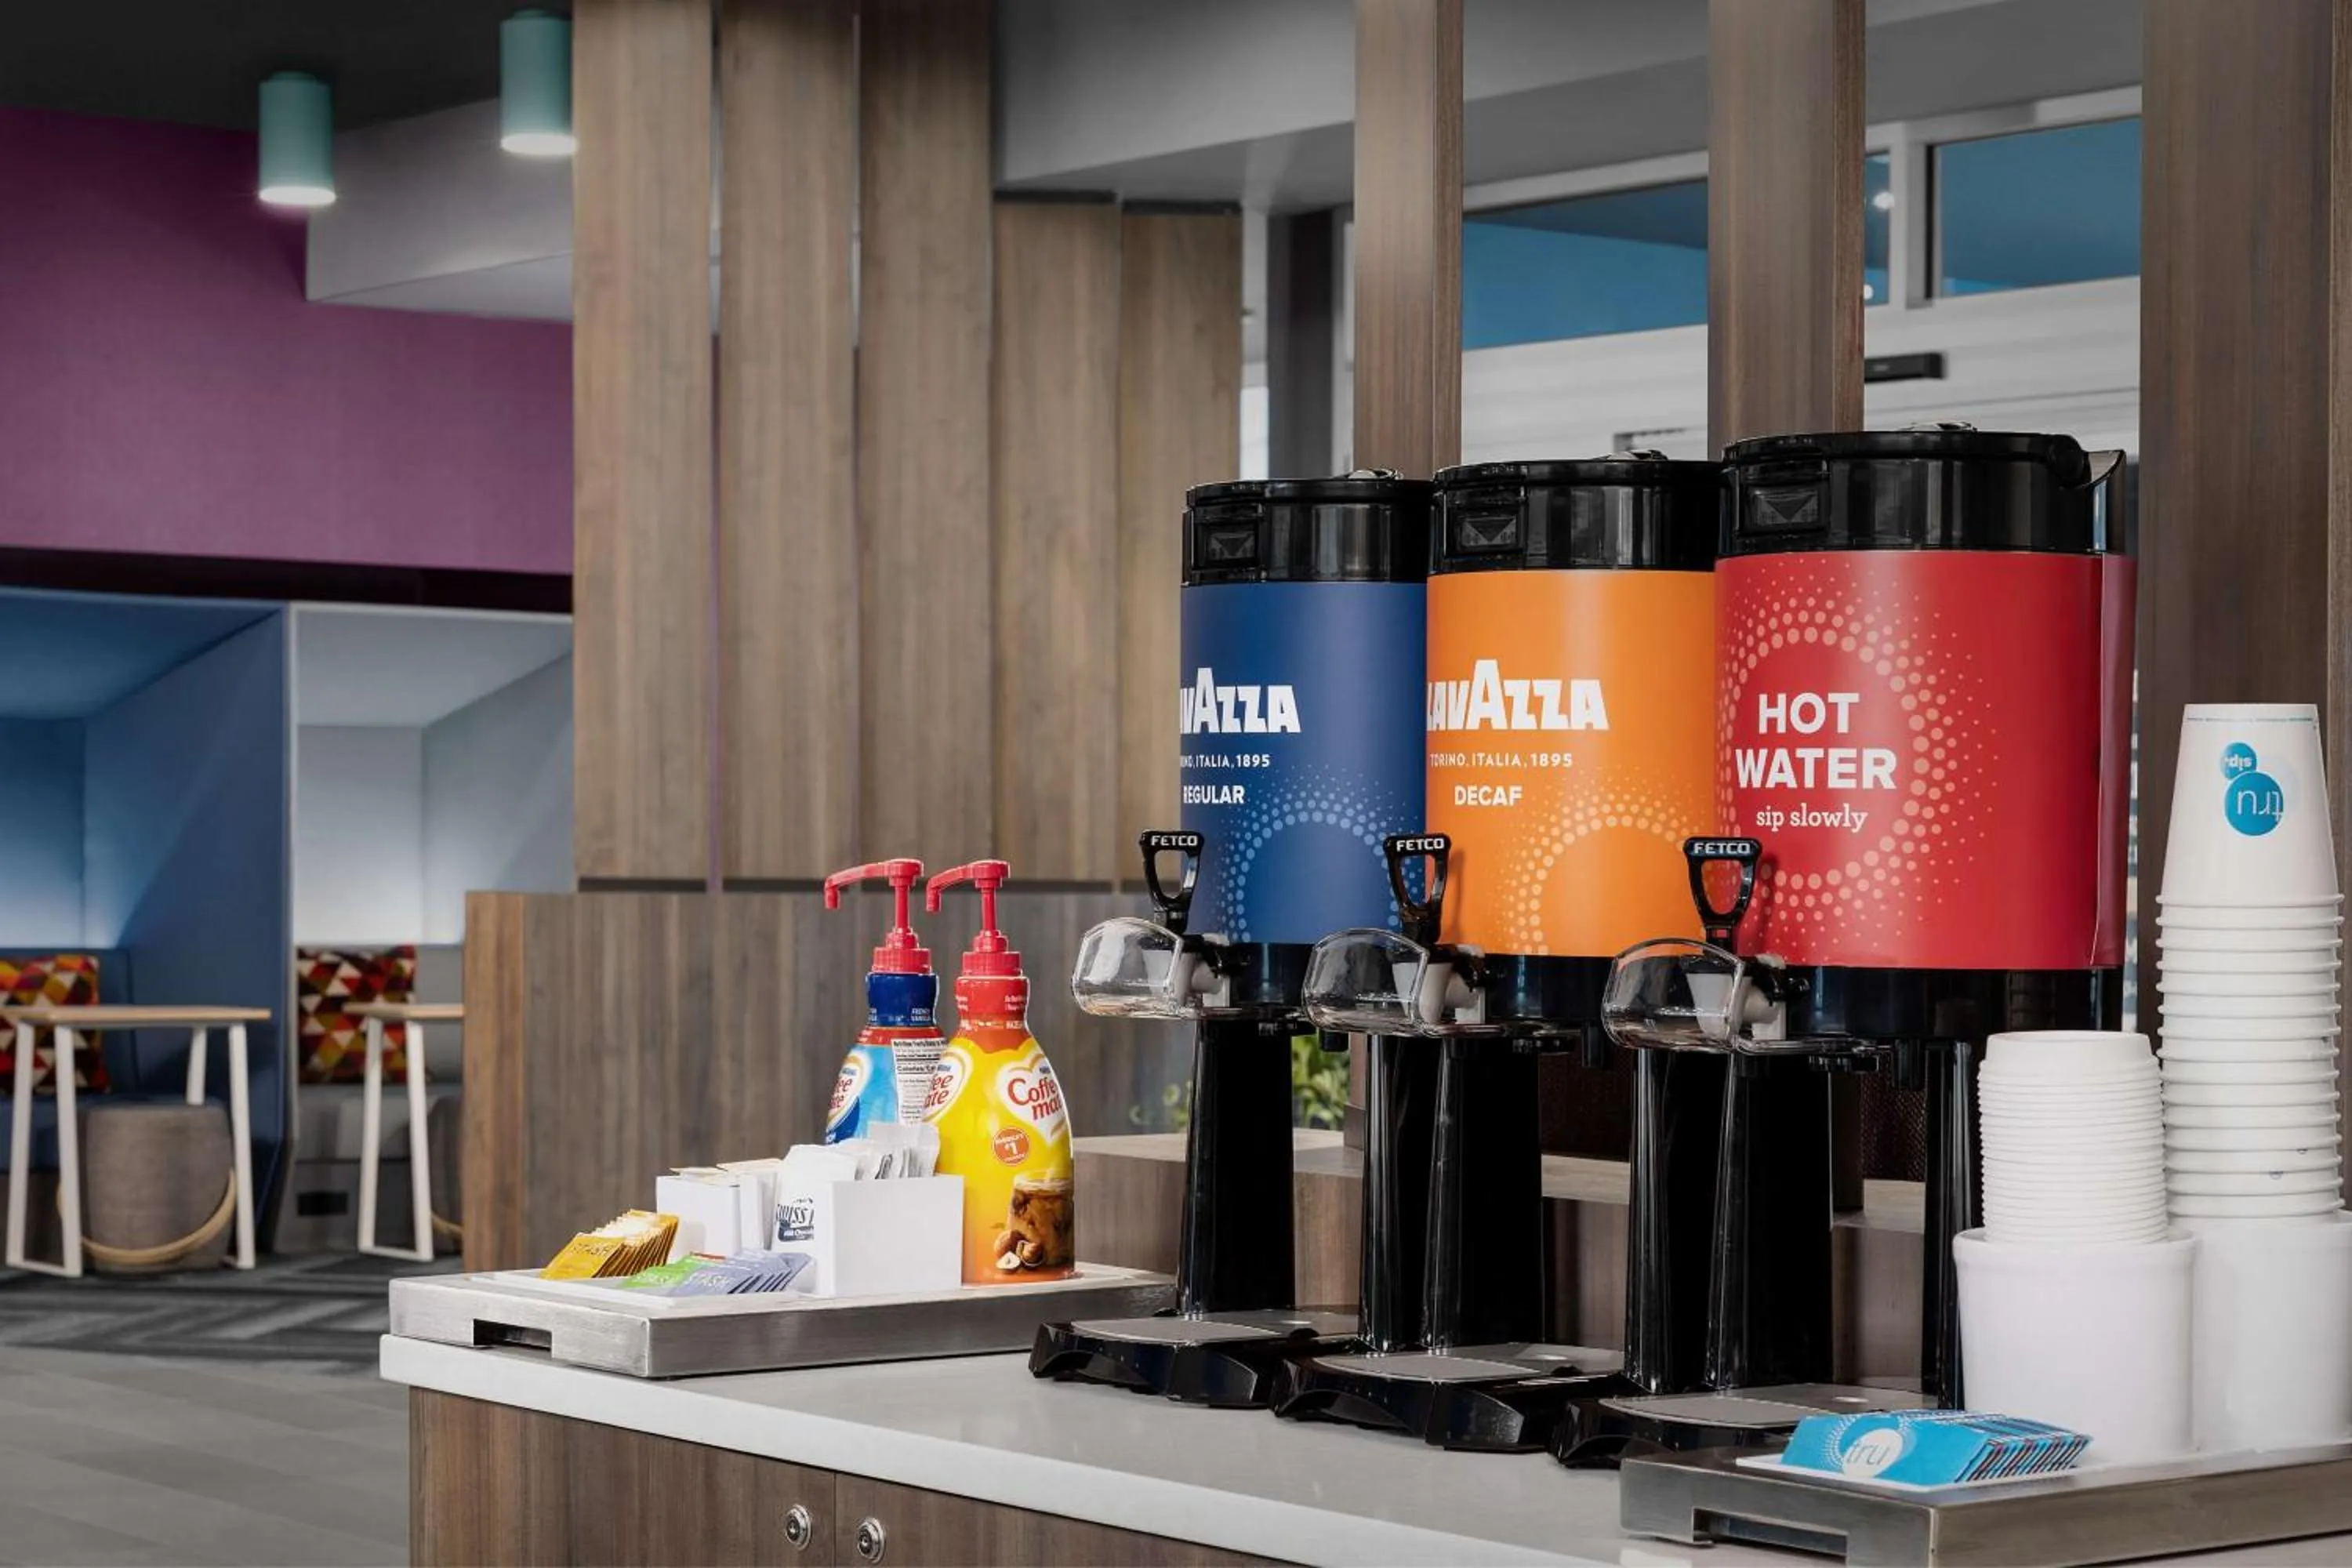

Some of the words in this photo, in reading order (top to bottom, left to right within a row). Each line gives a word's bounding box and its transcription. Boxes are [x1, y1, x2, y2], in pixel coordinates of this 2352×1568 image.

[1427, 659, 1610, 731] LAVAZZA
[1758, 692, 1860, 734] HOT
[1236, 753, 1271, 768] 1895
[1530, 753, 1573, 768] 1895
[1734, 747, 1897, 789] WATER
[1183, 785, 1246, 804] REGULAR
[1454, 786, 1523, 806] DECAF
[2237, 789, 2283, 823] tru
[1755, 805, 1784, 832] sip
[1789, 803, 1868, 833] slowly
[1150, 835, 1199, 846] FETCO
[1396, 837, 1445, 851] FETCO
[1693, 842, 1751, 855] FETCO
[1007, 1076, 1058, 1106] Coffe
[1847, 1441, 1890, 1467] tru
